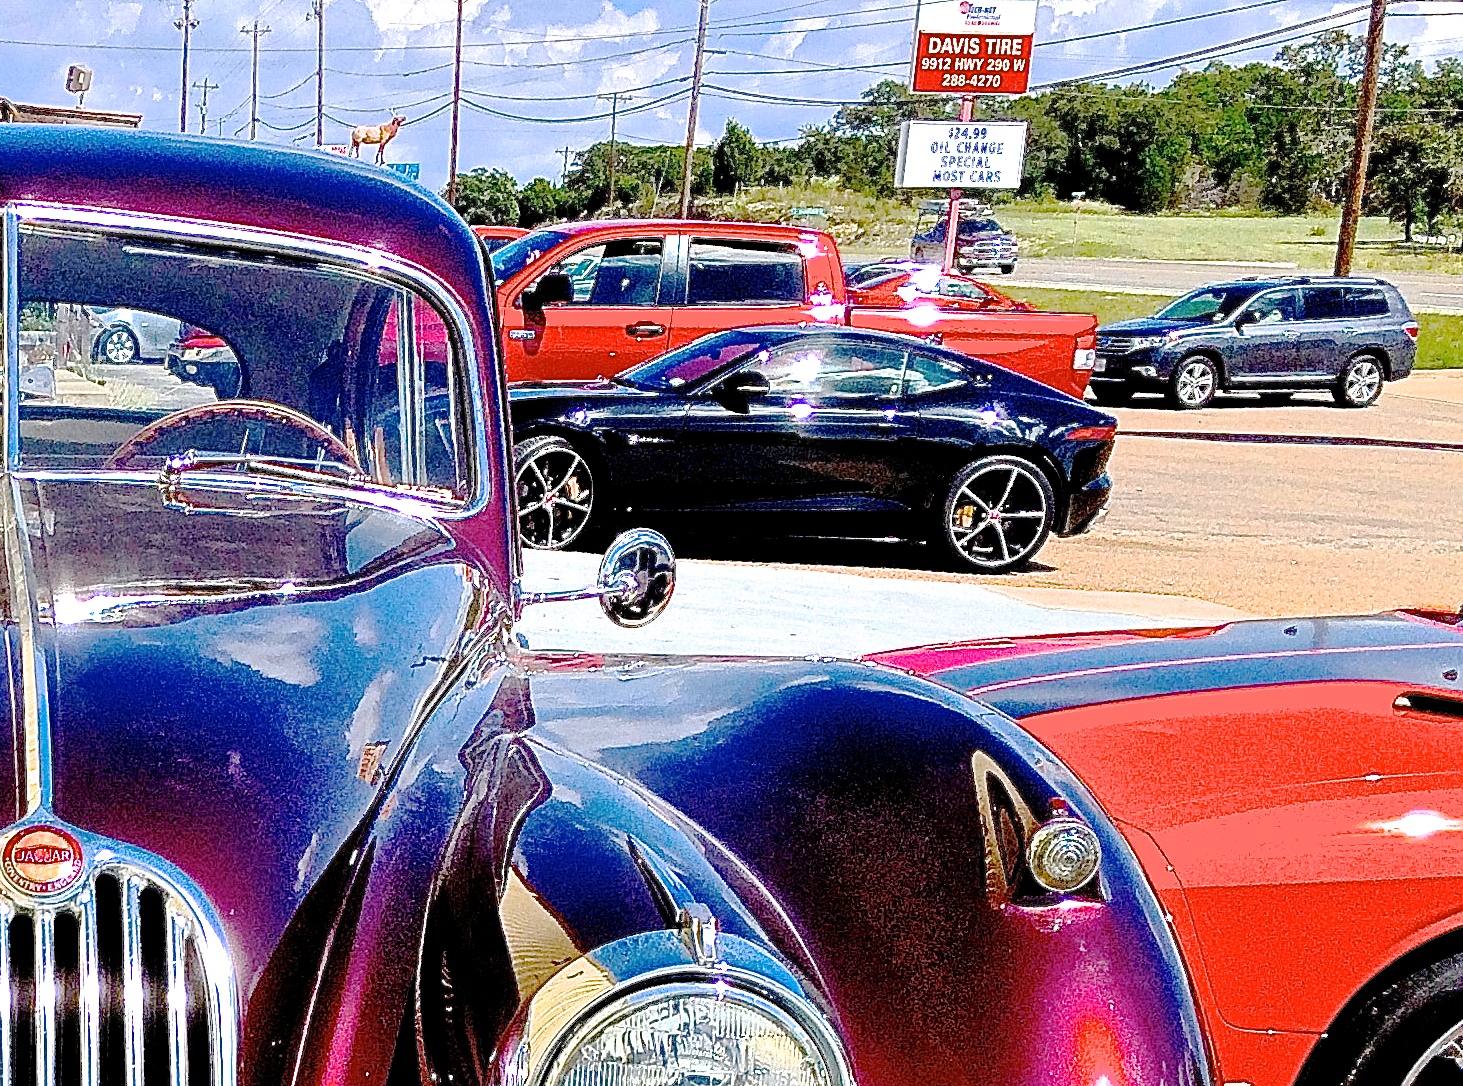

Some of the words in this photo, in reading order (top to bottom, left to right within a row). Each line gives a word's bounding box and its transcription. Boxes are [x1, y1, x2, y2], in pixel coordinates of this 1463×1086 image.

[928, 37, 980, 55] DAVIS
[985, 38, 1023, 55] TIRE
[921, 57, 952, 70] 9912
[954, 58, 984, 71] HWY
[986, 59, 1010, 71] 290
[1013, 59, 1026, 72] W
[942, 74, 1001, 87] 288-4270
[948, 127, 988, 140] $24.99
[930, 141, 951, 154] OIL
[956, 141, 1004, 154] CHANGE
[940, 155, 991, 169] SPECIAL
[932, 170, 966, 183] MOST
[969, 170, 1002, 183] CARS
[17, 848, 70, 863] JAGUAR
